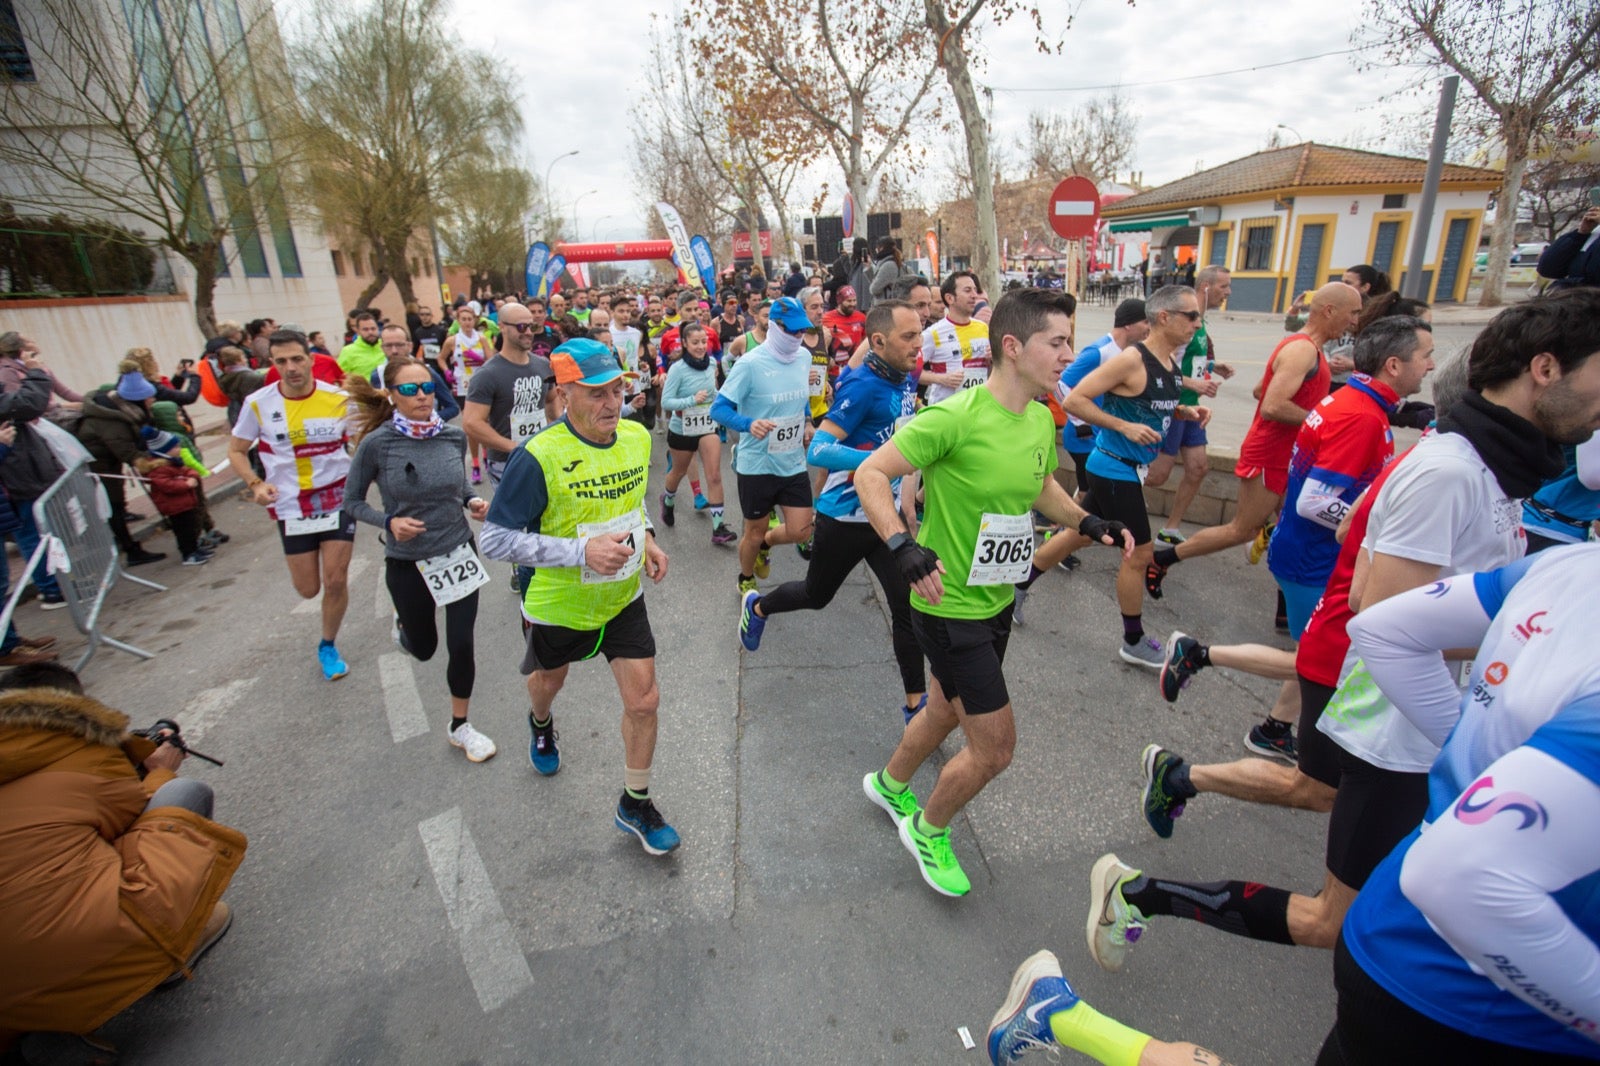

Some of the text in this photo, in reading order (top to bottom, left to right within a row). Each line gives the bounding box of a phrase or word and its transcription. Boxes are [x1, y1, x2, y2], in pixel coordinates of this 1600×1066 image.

[514, 375, 542, 392] GOOD
[513, 388, 542, 406] VIBES
[519, 422, 542, 436] 821
[685, 415, 713, 427] 3115
[777, 424, 800, 441] 637
[568, 465, 644, 489] ATLETISMO
[978, 536, 1032, 564] 3065
[429, 559, 479, 591] 3129
